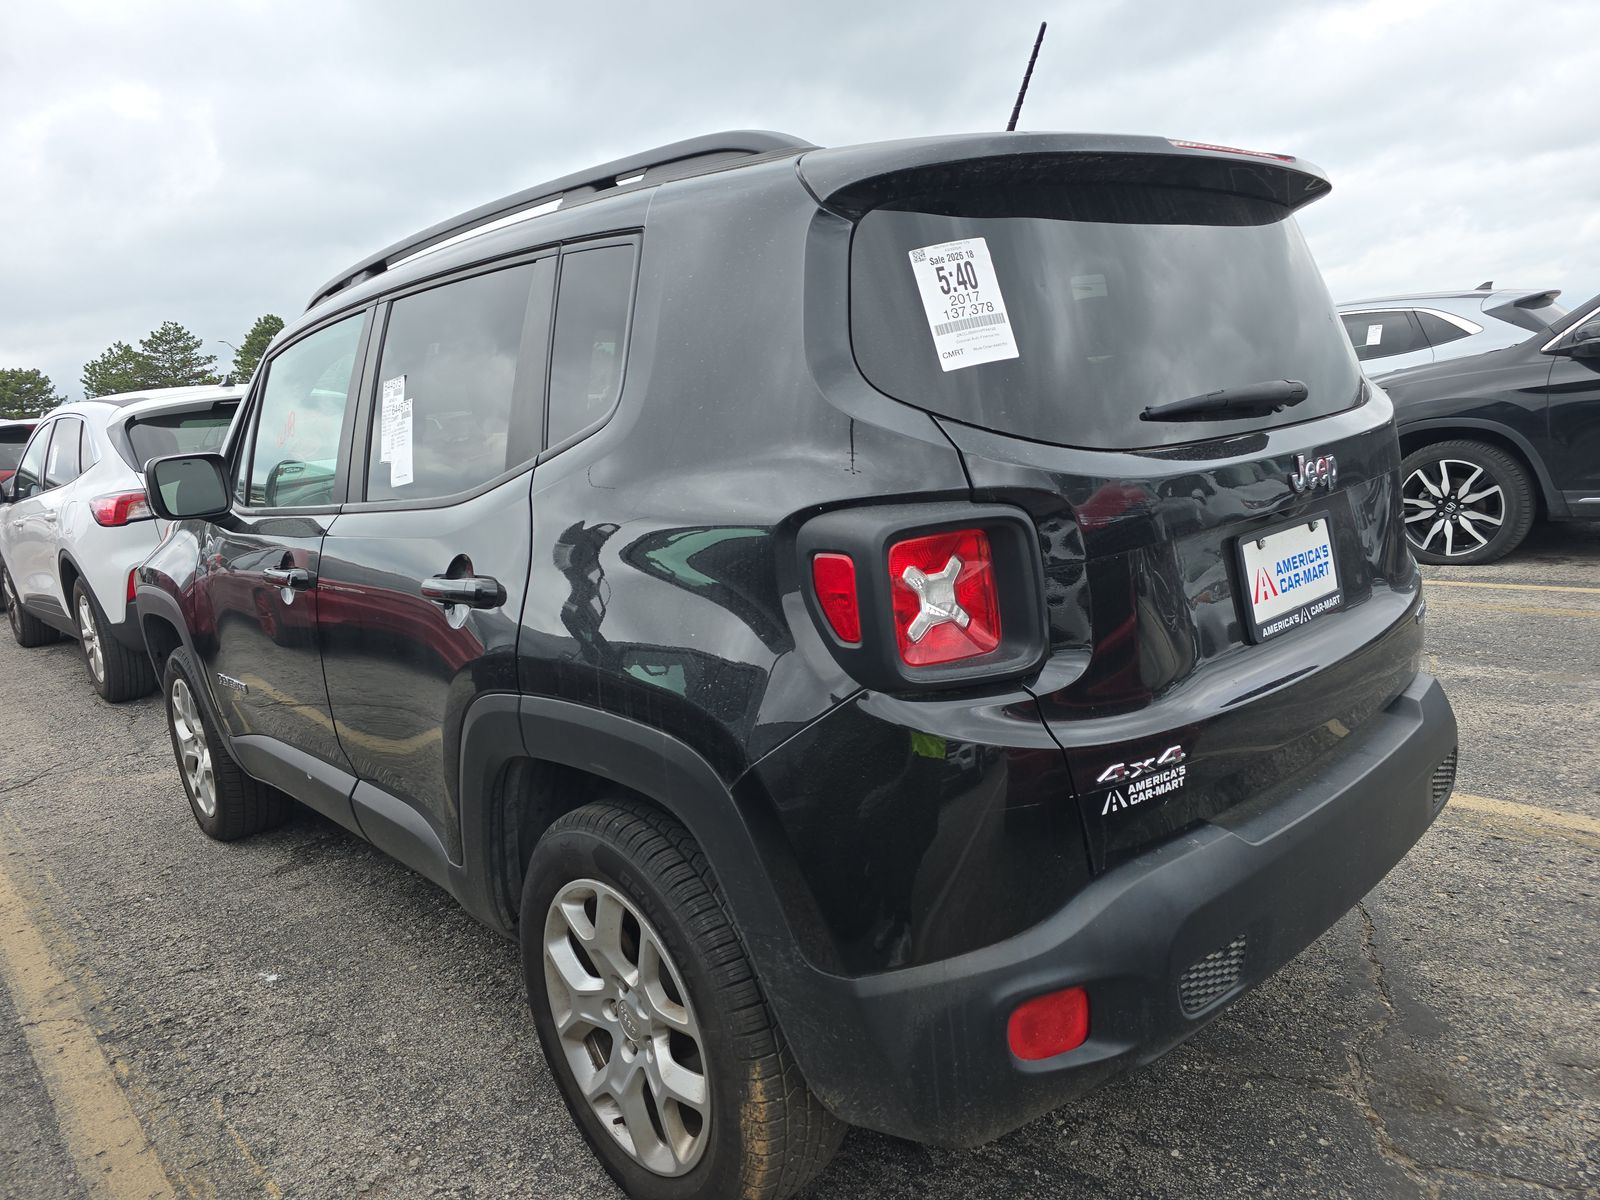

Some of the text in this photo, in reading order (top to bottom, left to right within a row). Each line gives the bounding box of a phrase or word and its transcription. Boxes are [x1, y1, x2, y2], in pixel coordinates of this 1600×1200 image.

[929, 255, 945, 266] Sale
[966, 250, 975, 259] 18
[935, 261, 979, 295] 5:40
[944, 301, 994, 320] 137,378
[949, 291, 980, 306] 2017
[942, 348, 964, 359] CMRT
[1289, 454, 1338, 493] Jeep
[1275, 543, 1329, 576] AMERICA'S
[1279, 561, 1330, 594] CAR-MART
[1262, 595, 1340, 637] AMERICA'S CAR-MART
[1127, 765, 1186, 795] AMERICA'S
[1129, 776, 1185, 805] CAR-MART
